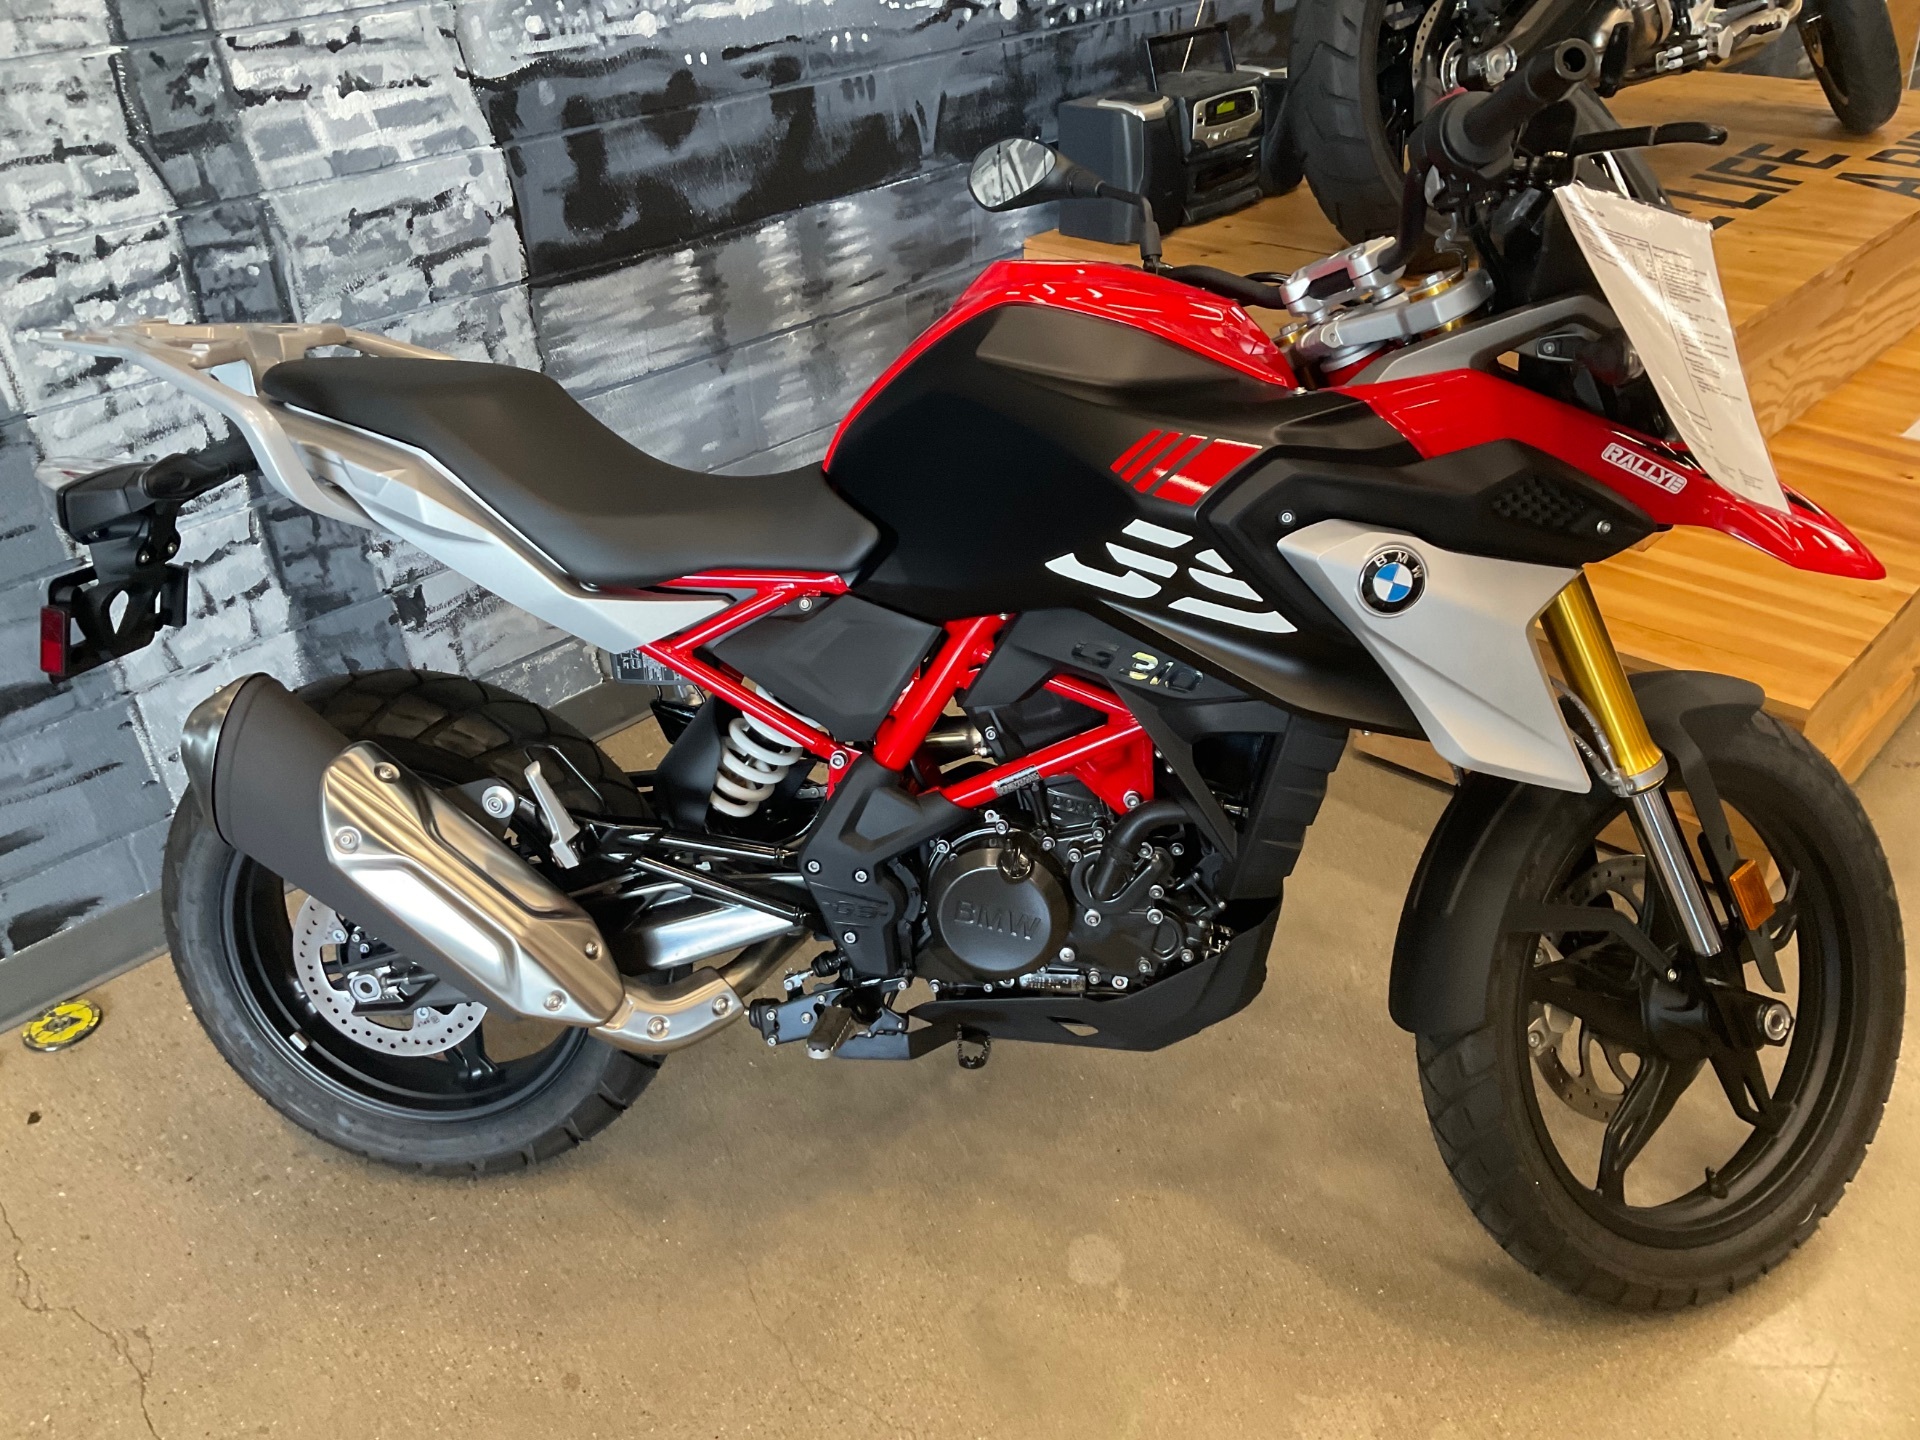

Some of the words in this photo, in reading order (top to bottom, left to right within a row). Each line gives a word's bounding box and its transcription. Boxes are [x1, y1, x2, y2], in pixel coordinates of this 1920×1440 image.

[1666, 143, 1852, 210] LIFE
[1602, 445, 1686, 492] RALLYE
[1373, 551, 1423, 579] BMW
[1071, 640, 1119, 669] G
[1120, 651, 1204, 693] 310
[954, 901, 1042, 941] BMW
